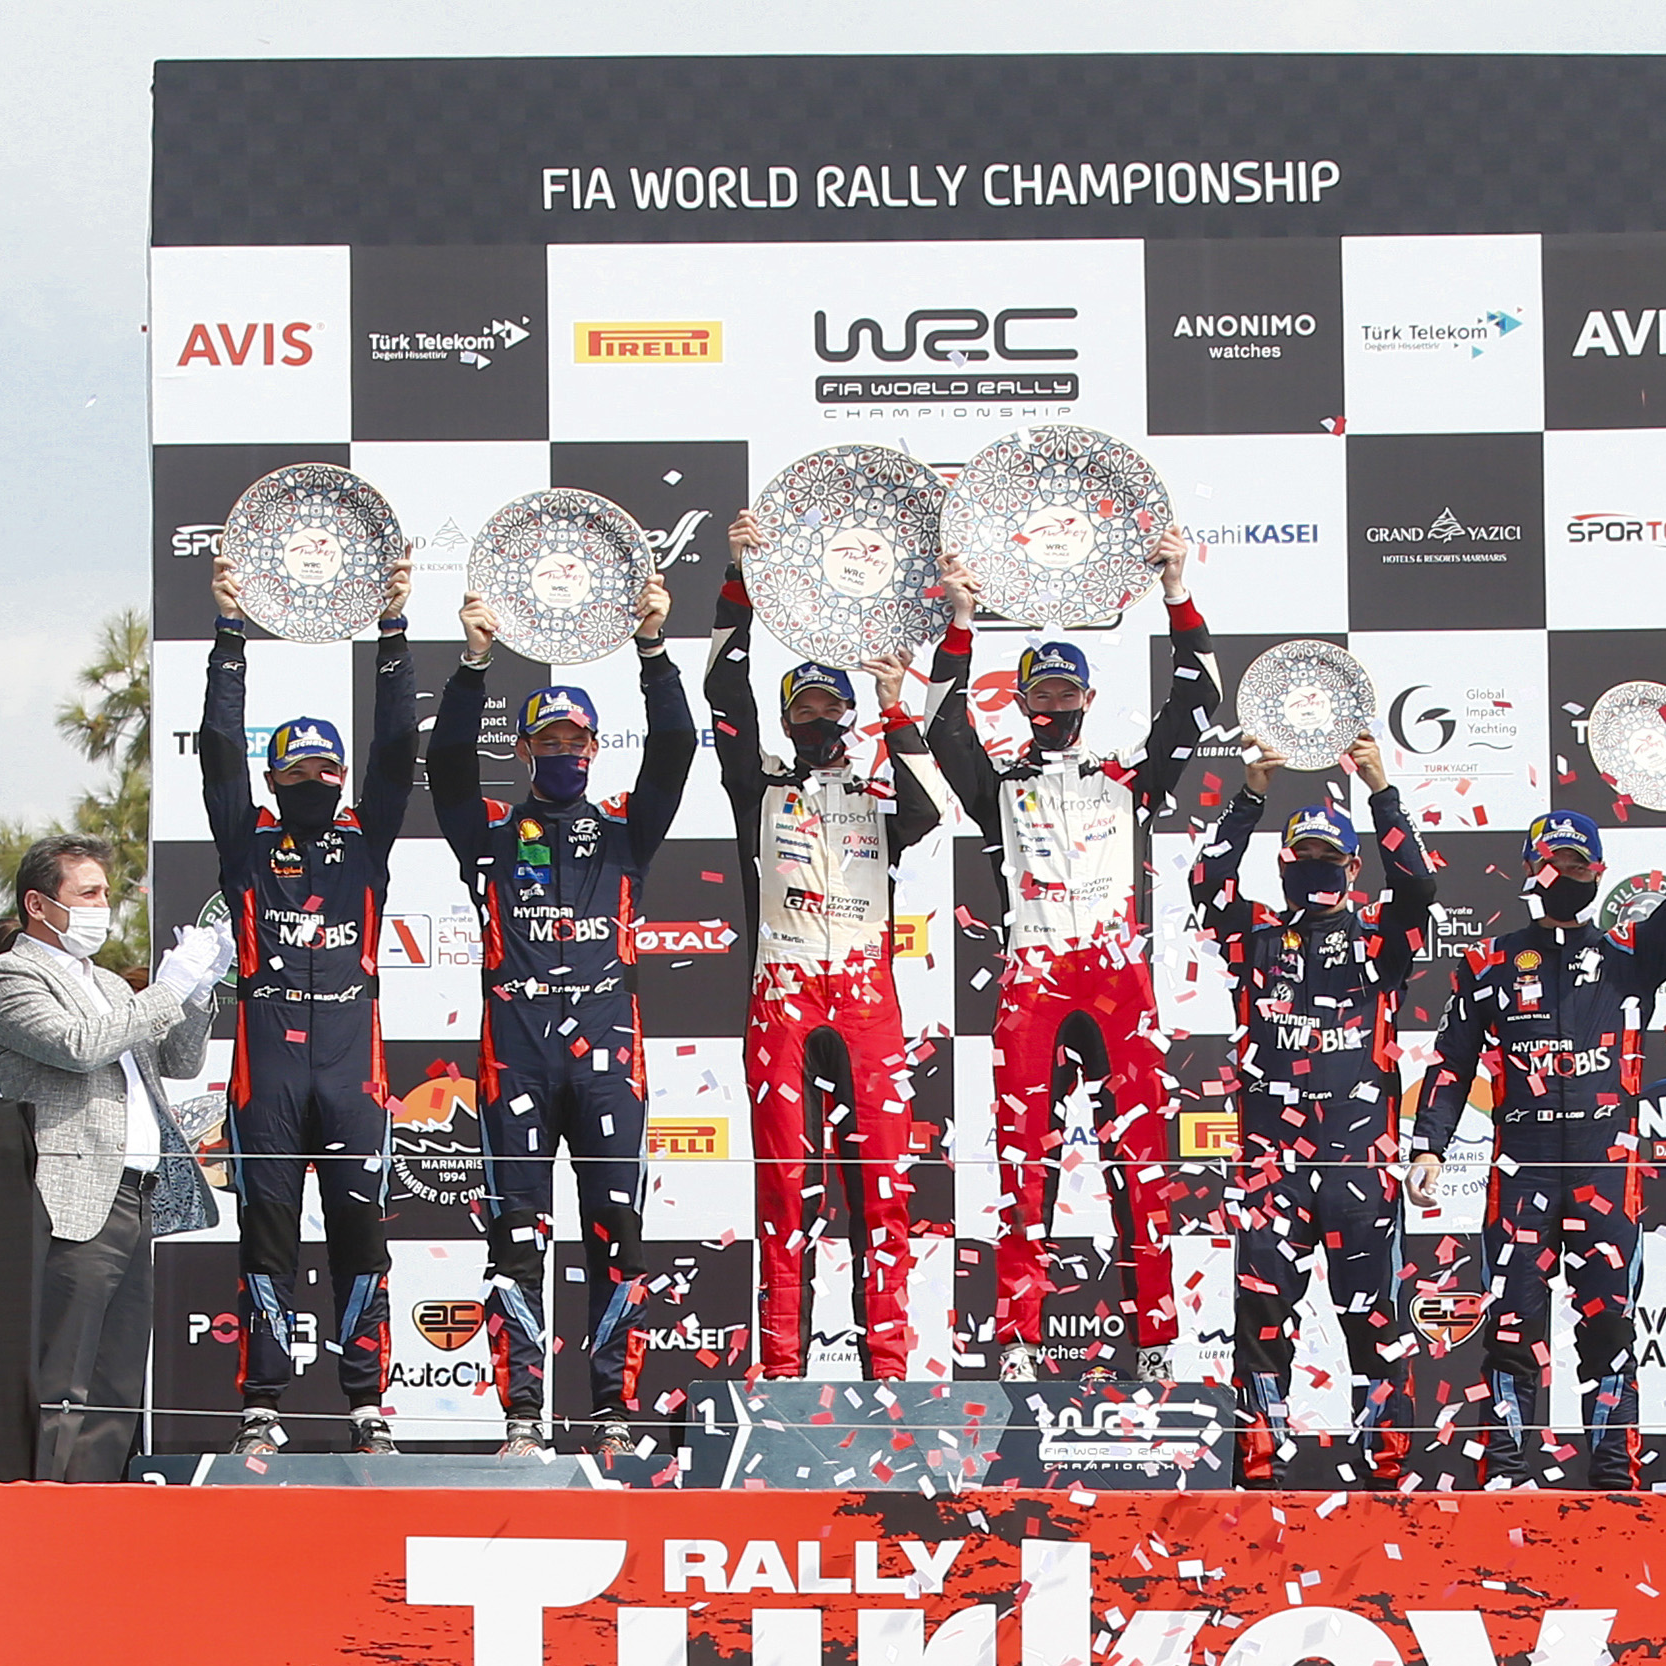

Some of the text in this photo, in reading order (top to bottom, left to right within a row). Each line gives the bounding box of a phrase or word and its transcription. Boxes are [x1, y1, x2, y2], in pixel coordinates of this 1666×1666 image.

[542, 160, 1340, 210] FIA WORLD RALLY CHAMPIONSHIP
[1173, 313, 1317, 338] ANONIMO
[1361, 324, 1488, 341] Türk Telekom
[368, 332, 494, 350] Türk Telekom
[588, 329, 710, 356] PIRELLI
[814, 307, 1079, 362] WRC
[177, 322, 313, 366] AVIS
[1208, 343, 1282, 359] watches
[822, 380, 1071, 397] FIA WORLD RALLY
[823, 406, 1072, 419] CHAMPIONSHIP
[1366, 525, 1522, 543] GRAND YAZICI
[1383, 554, 1415, 564] HOTELS
[1424, 554, 1460, 563] RESORTS
[1462, 553, 1507, 562] MARMARIS
[843, 566, 866, 581] WRC
[1466, 688, 1505, 701] Global
[1465, 706, 1506, 719] Impact
[1467, 723, 1517, 737] Yachting
[1039, 789, 1112, 812] Microsoft
[513, 905, 574, 919] HYUNDAI
[529, 916, 611, 943] MOBIS
[438, 1171, 467, 1183] 1994
[439, 1192, 458, 1206] OF
[663, 1539, 967, 1595] RALLY
